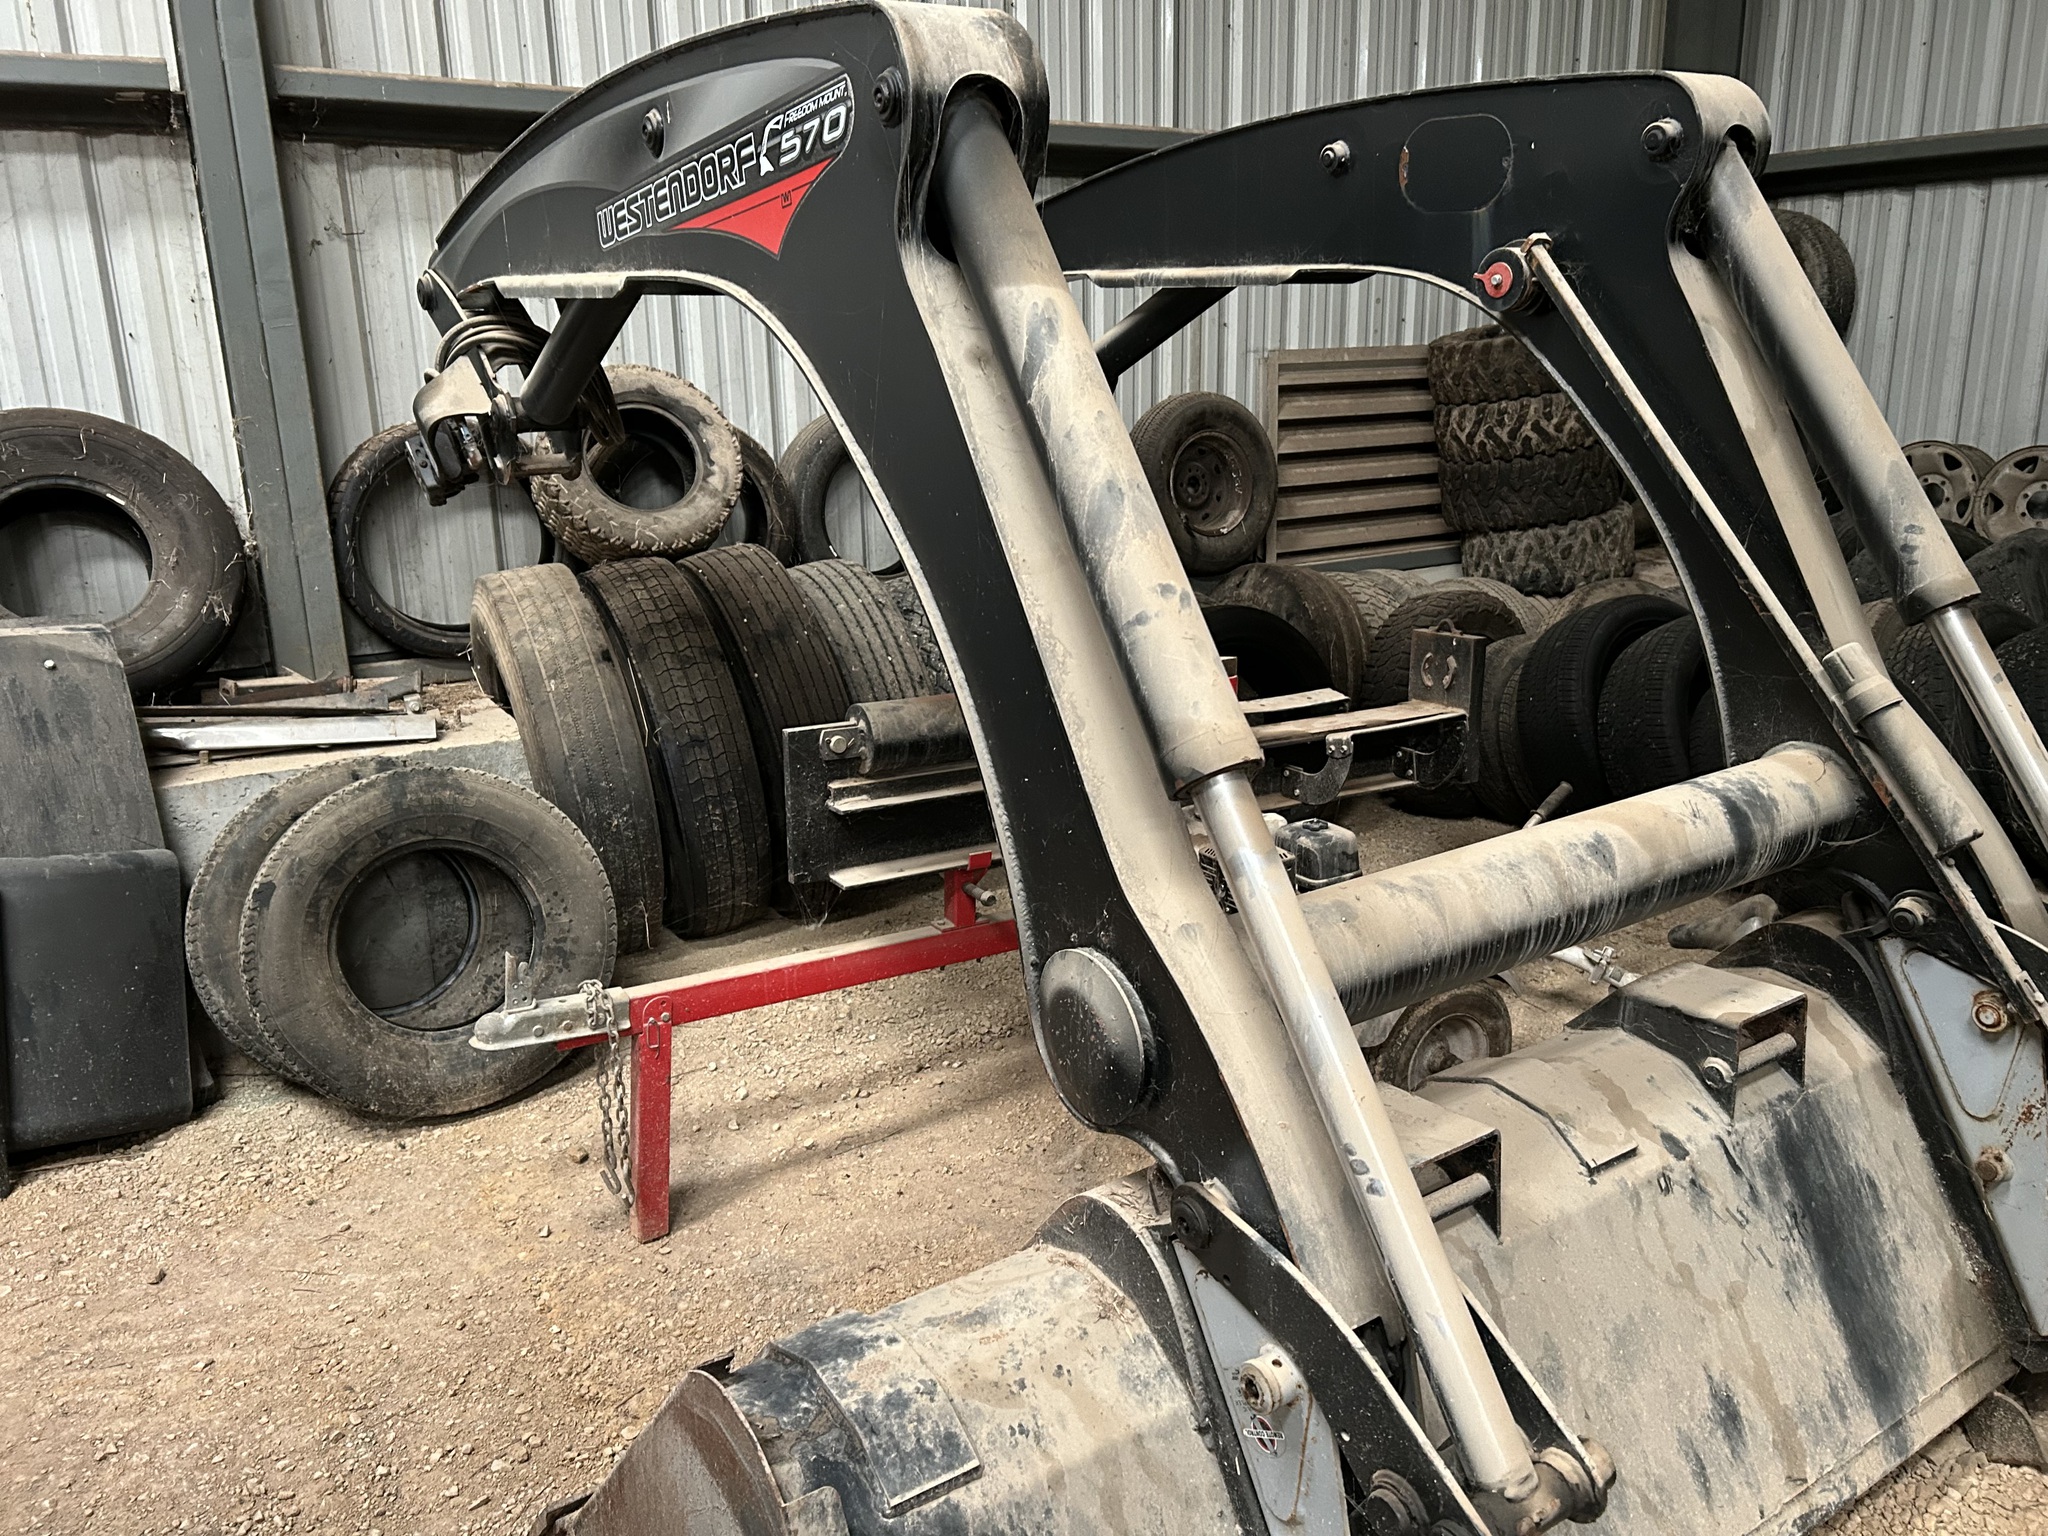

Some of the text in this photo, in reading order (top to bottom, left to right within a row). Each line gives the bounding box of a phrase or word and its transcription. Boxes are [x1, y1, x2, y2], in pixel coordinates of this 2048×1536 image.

[778, 103, 847, 167] 570
[784, 100, 819, 127] FREEDOM
[597, 133, 757, 248] WESTENDORF
